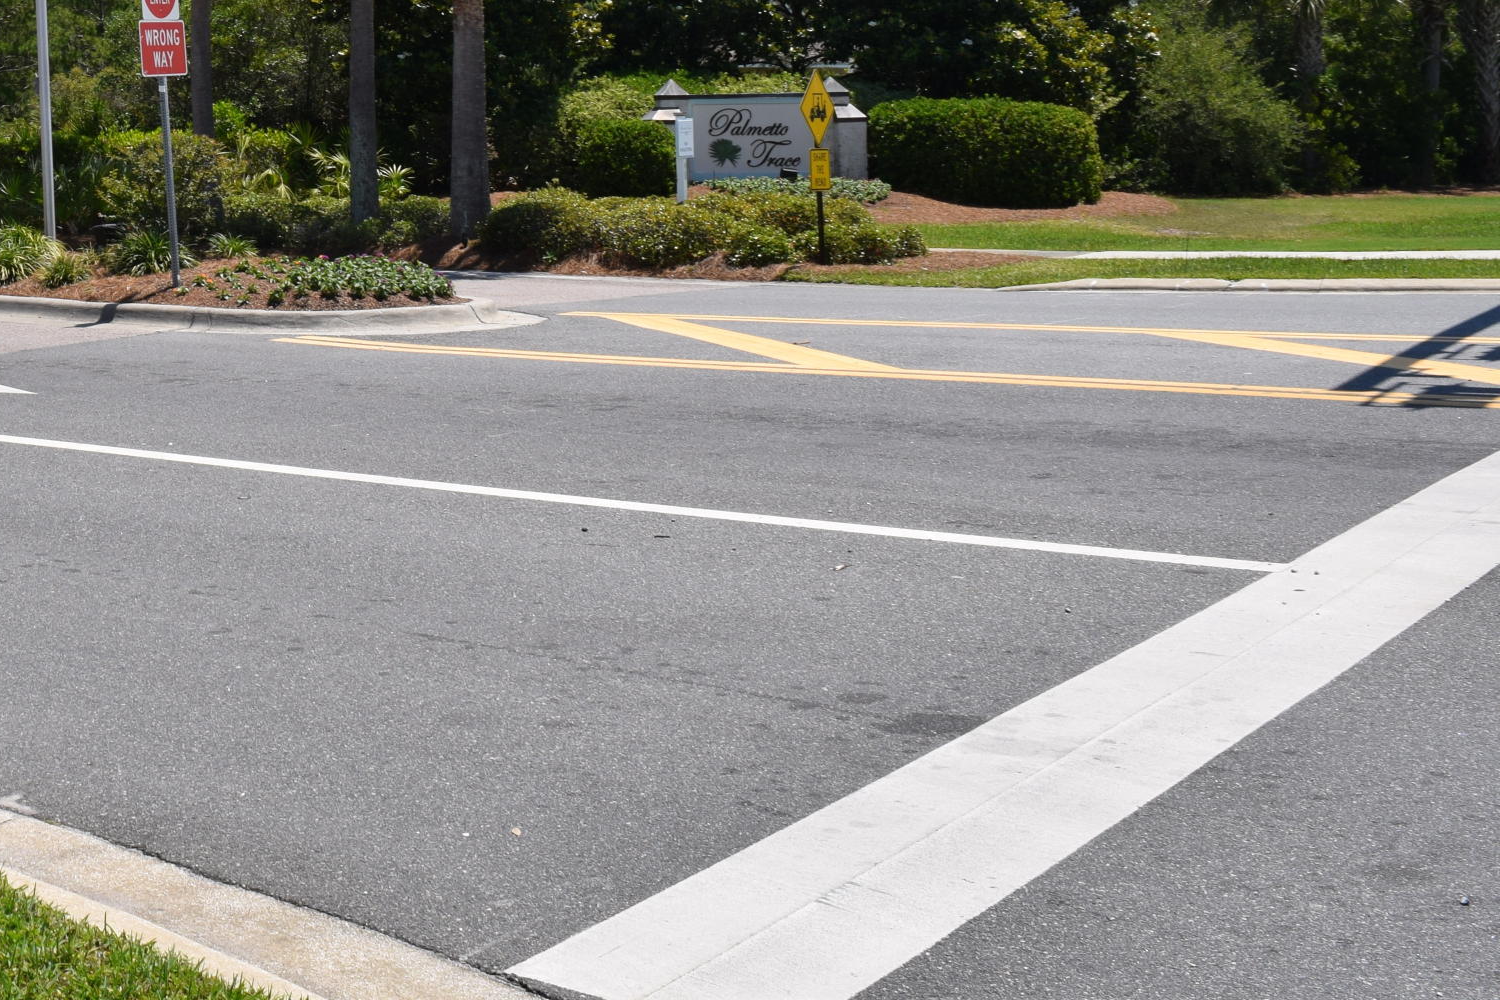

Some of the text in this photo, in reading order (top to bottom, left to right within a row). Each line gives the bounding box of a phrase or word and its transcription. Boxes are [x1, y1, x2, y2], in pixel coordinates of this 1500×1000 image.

[145, 29, 180, 46] WRONG
[153, 50, 174, 68] WAY
[708, 108, 789, 136] Palmetto
[747, 139, 801, 167] Trace
